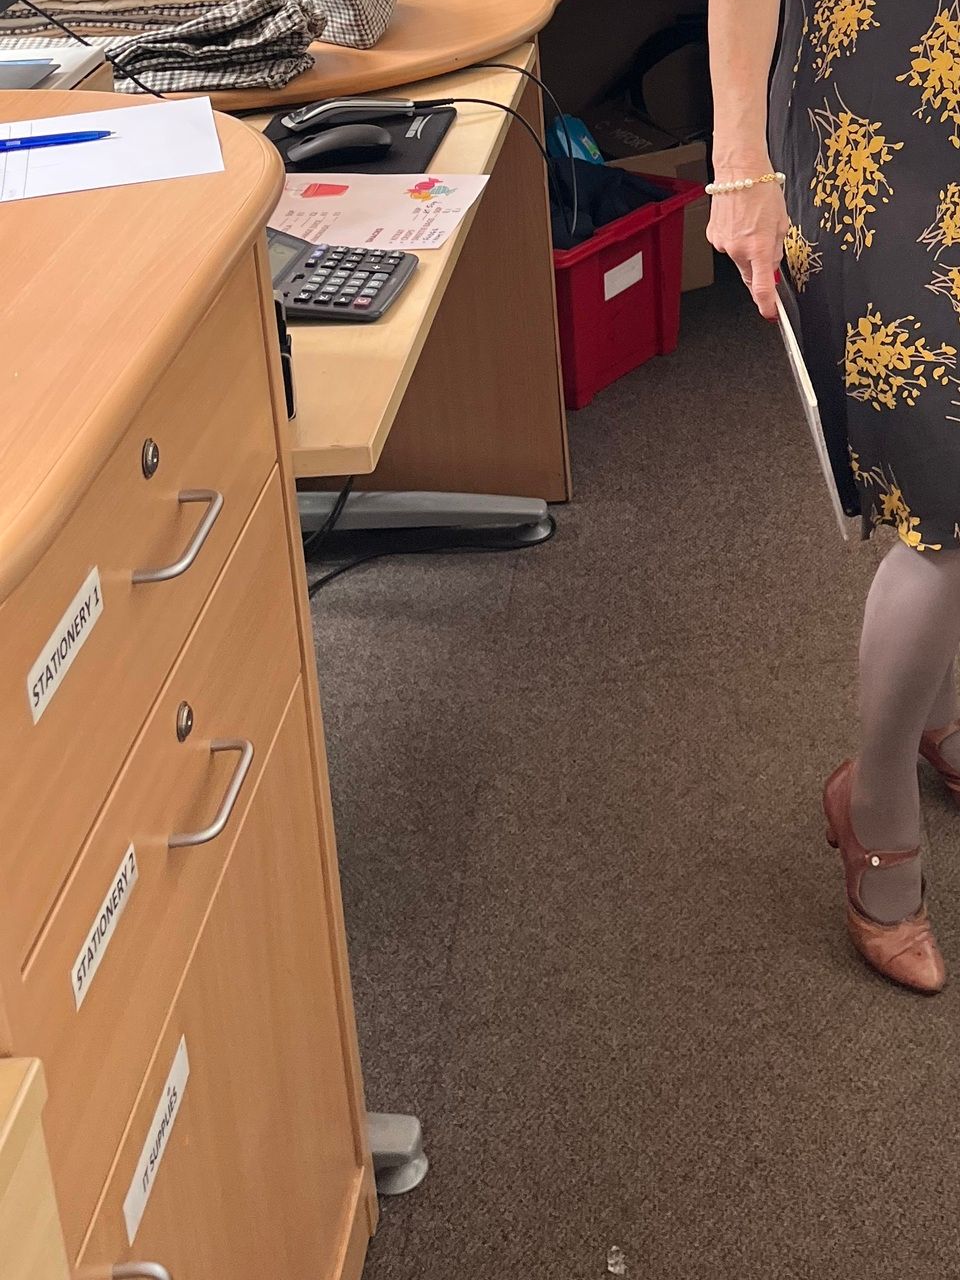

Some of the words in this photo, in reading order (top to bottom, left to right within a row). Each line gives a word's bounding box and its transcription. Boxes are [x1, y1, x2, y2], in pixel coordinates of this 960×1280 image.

[32, 595, 91, 708] STATIONERY
[94, 585, 100, 607] 1
[76, 864, 128, 991] STATIONERY
[128, 852, 136, 874] 2
[142, 1166, 150, 1193] IT
[149, 1086, 178, 1172] SUPPLIES
